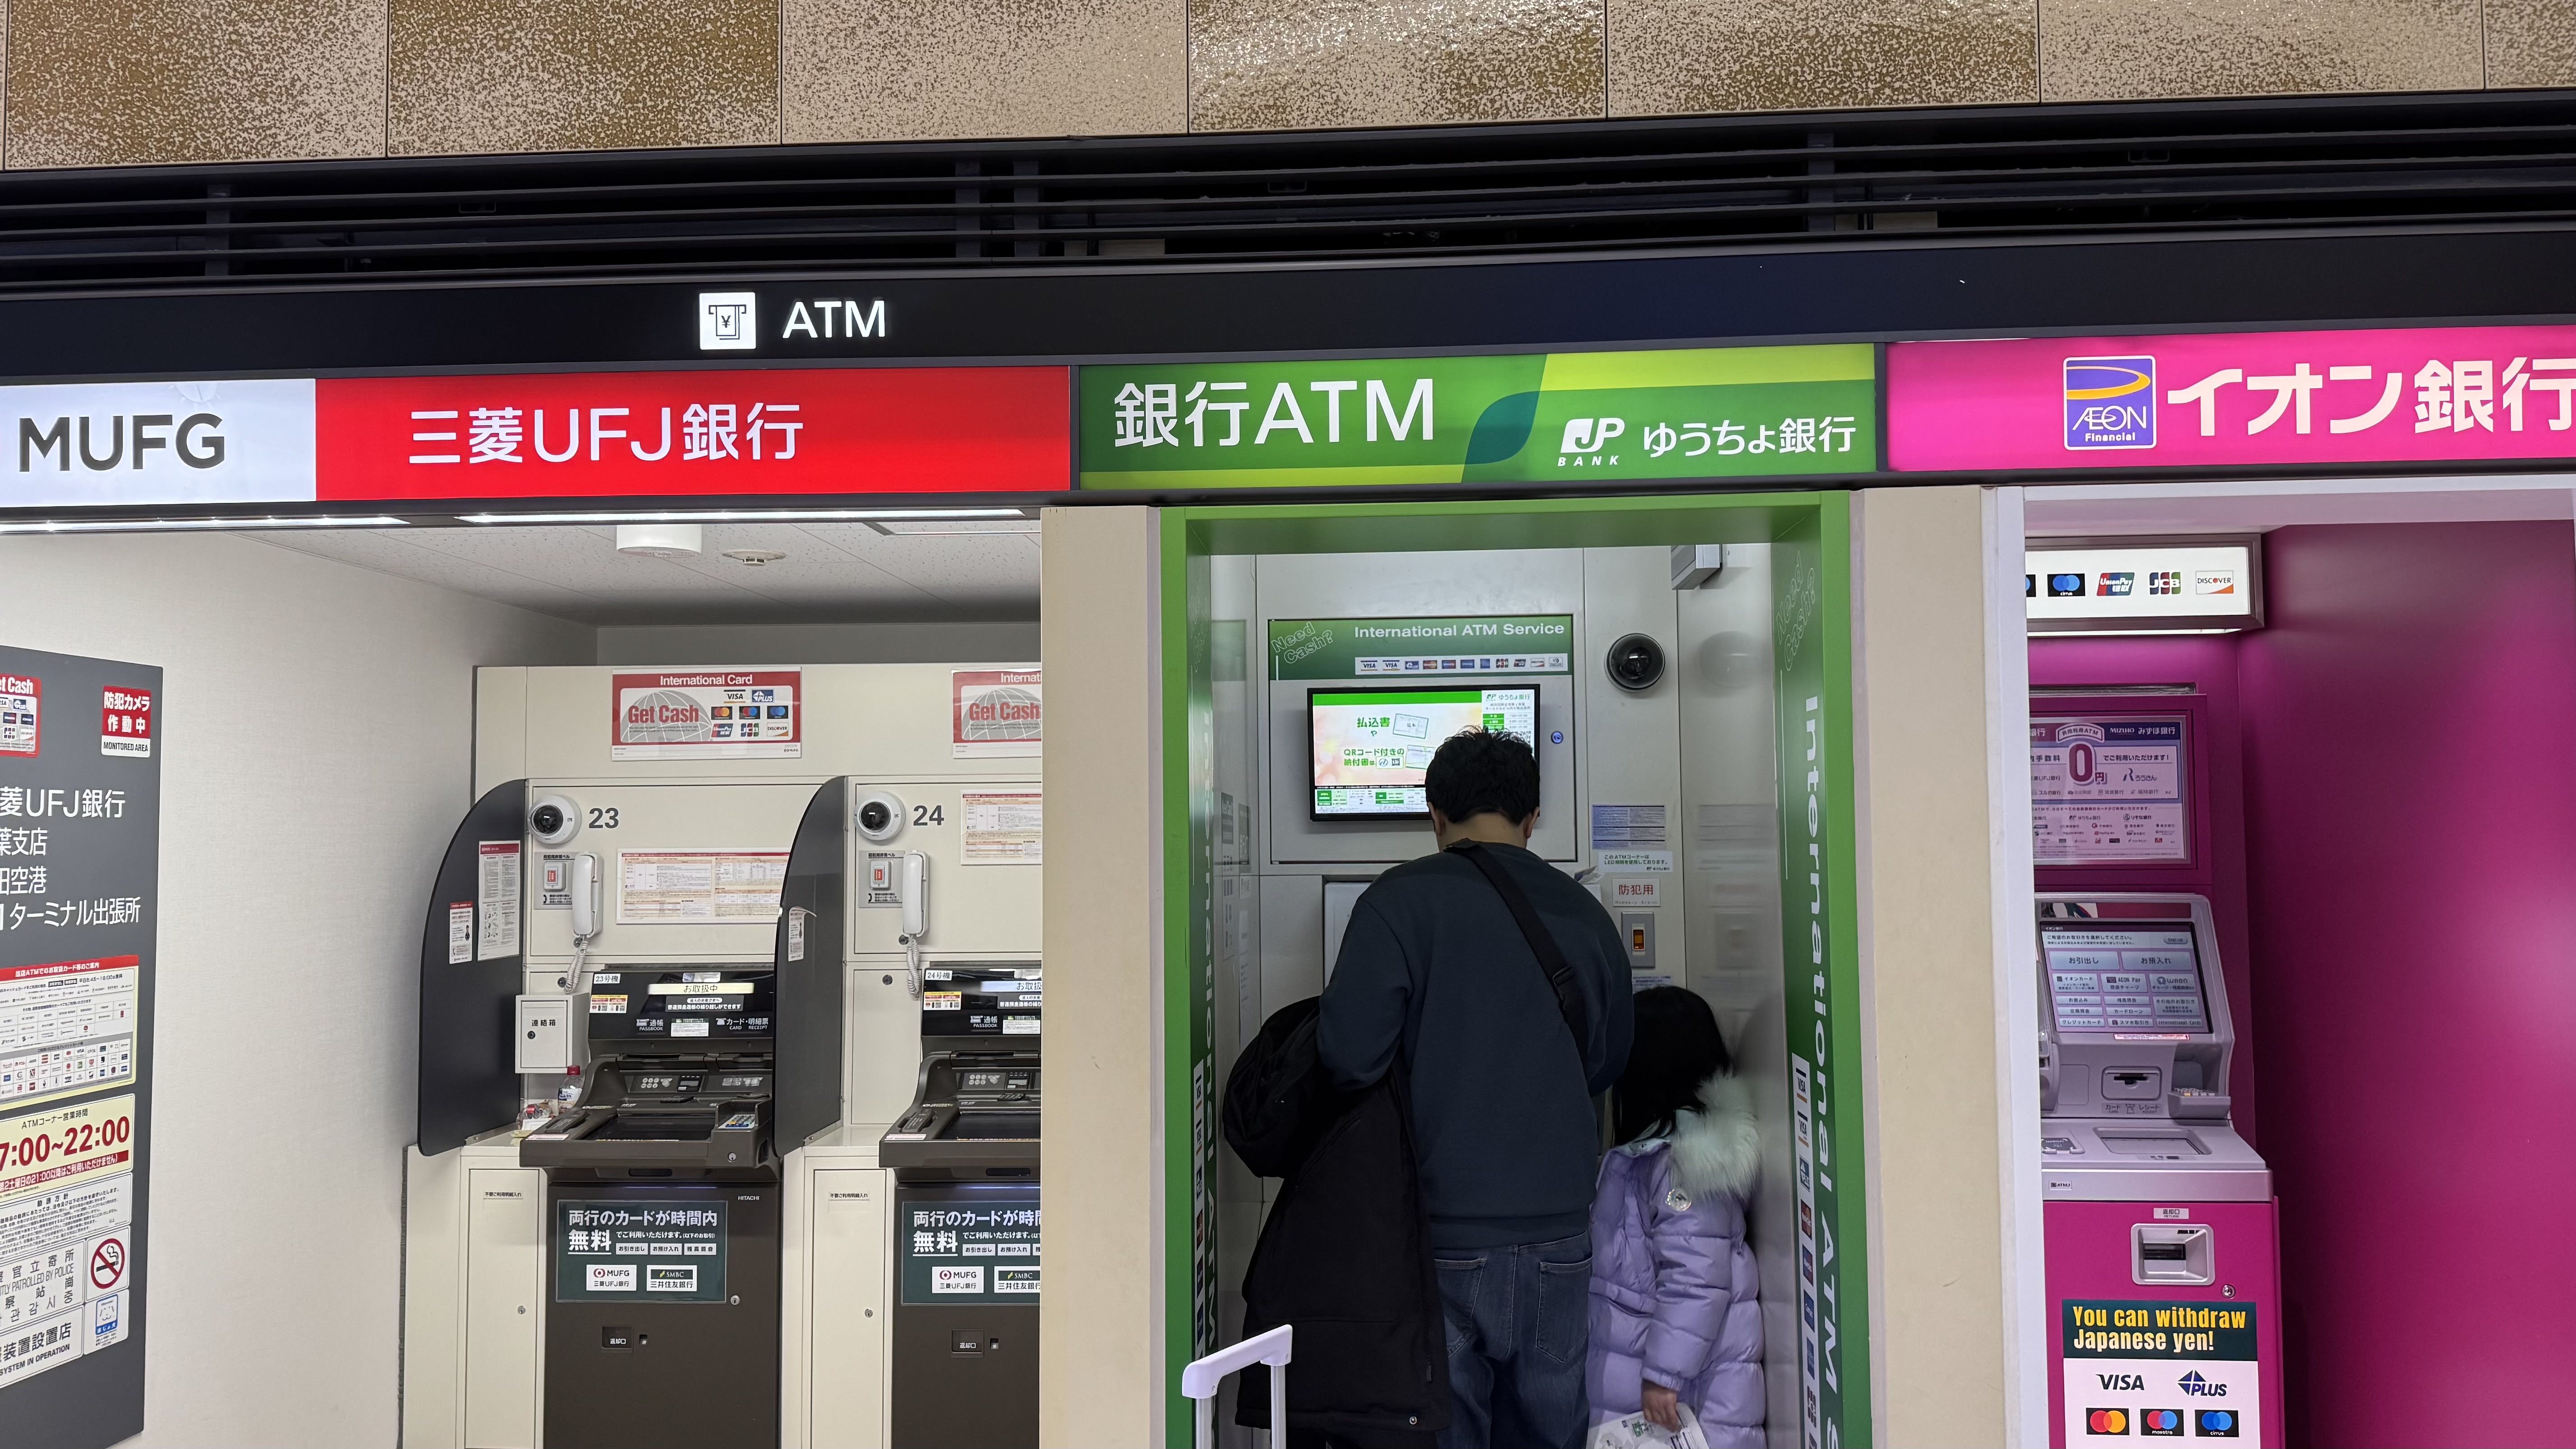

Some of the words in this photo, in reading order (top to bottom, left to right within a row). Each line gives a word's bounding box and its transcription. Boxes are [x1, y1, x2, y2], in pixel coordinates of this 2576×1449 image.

[782, 300, 885, 339] ATM
[2167, 357, 2576, 437] イオン銀行
[1114, 378, 1434, 447] 銀行ATM
[19, 413, 225, 473] MUFG
[409, 402, 804, 464] 三菱UFJ銀行
[1643, 416, 1856, 458] ゆうちょ銀行
[2085, 432, 2136, 442] Financial
[1557, 455, 1619, 467] BANK
[2100, 577, 2133, 586] UnionPay
[2149, 579, 2180, 588] JCB
[1270, 621, 1316, 653] Need
[1354, 625, 1457, 639] International
[1462, 624, 1498, 637] ATM
[1503, 622, 1565, 636] Service
[1283, 629, 1334, 664] Cash?
[8, 676, 33, 695] Cash
[660, 675, 725, 685] International
[727, 674, 753, 685] Card
[1001, 673, 1041, 683] Internat
[103, 691, 150, 712] 防犯カメラ
[969, 702, 996, 721] Get
[999, 702, 1040, 721] Cash
[107, 714, 146, 734] 作動中
[628, 705, 656, 724] Get
[658, 704, 699, 723] Cash
[2138, 727, 2176, 735] みずほ銀行
[103, 741, 134, 751] MONITORED
[134, 743, 148, 752] AREA
[1343, 748, 1404, 757] QRコード付きの
[588, 807, 620, 829] 23
[913, 805, 945, 826] 24
[1619, 884, 1653, 896] 防犯用
[683, 984, 718, 993] お取扱中
[531, 1019, 557, 1027] 連絡箱
[1805, 696, 1833, 1192] International
[1821, 1210, 1838, 1394] ATM
[22, 1108, 88, 1130] ATMコーナー営業時間
[568, 1210, 718, 1227] 両行のカードが時間内
[568, 1229, 612, 1252] 無料
[913, 1230, 958, 1253] 無料
[12, 1274, 45, 1293] PATROLLED
[46, 1271, 54, 1282] BY
[54, 1263, 74, 1279] POLICE
[650, 1281, 694, 1289] 三井住友銀行
[2073, 1306, 2107, 1327] You
[2114, 1309, 2149, 1327] can
[2156, 1306, 2246, 1329] withdraw
[0, 1322, 72, 1362] 装置設置店
[2073, 1329, 2166, 1352] Japanese
[2173, 1331, 2214, 1353] yen!
[27, 1357, 34, 1366] IN
[35, 1343, 70, 1363] OPERATION
[2095, 1374, 2145, 1391] VISA
[2191, 1383, 2227, 1397] PLUS
